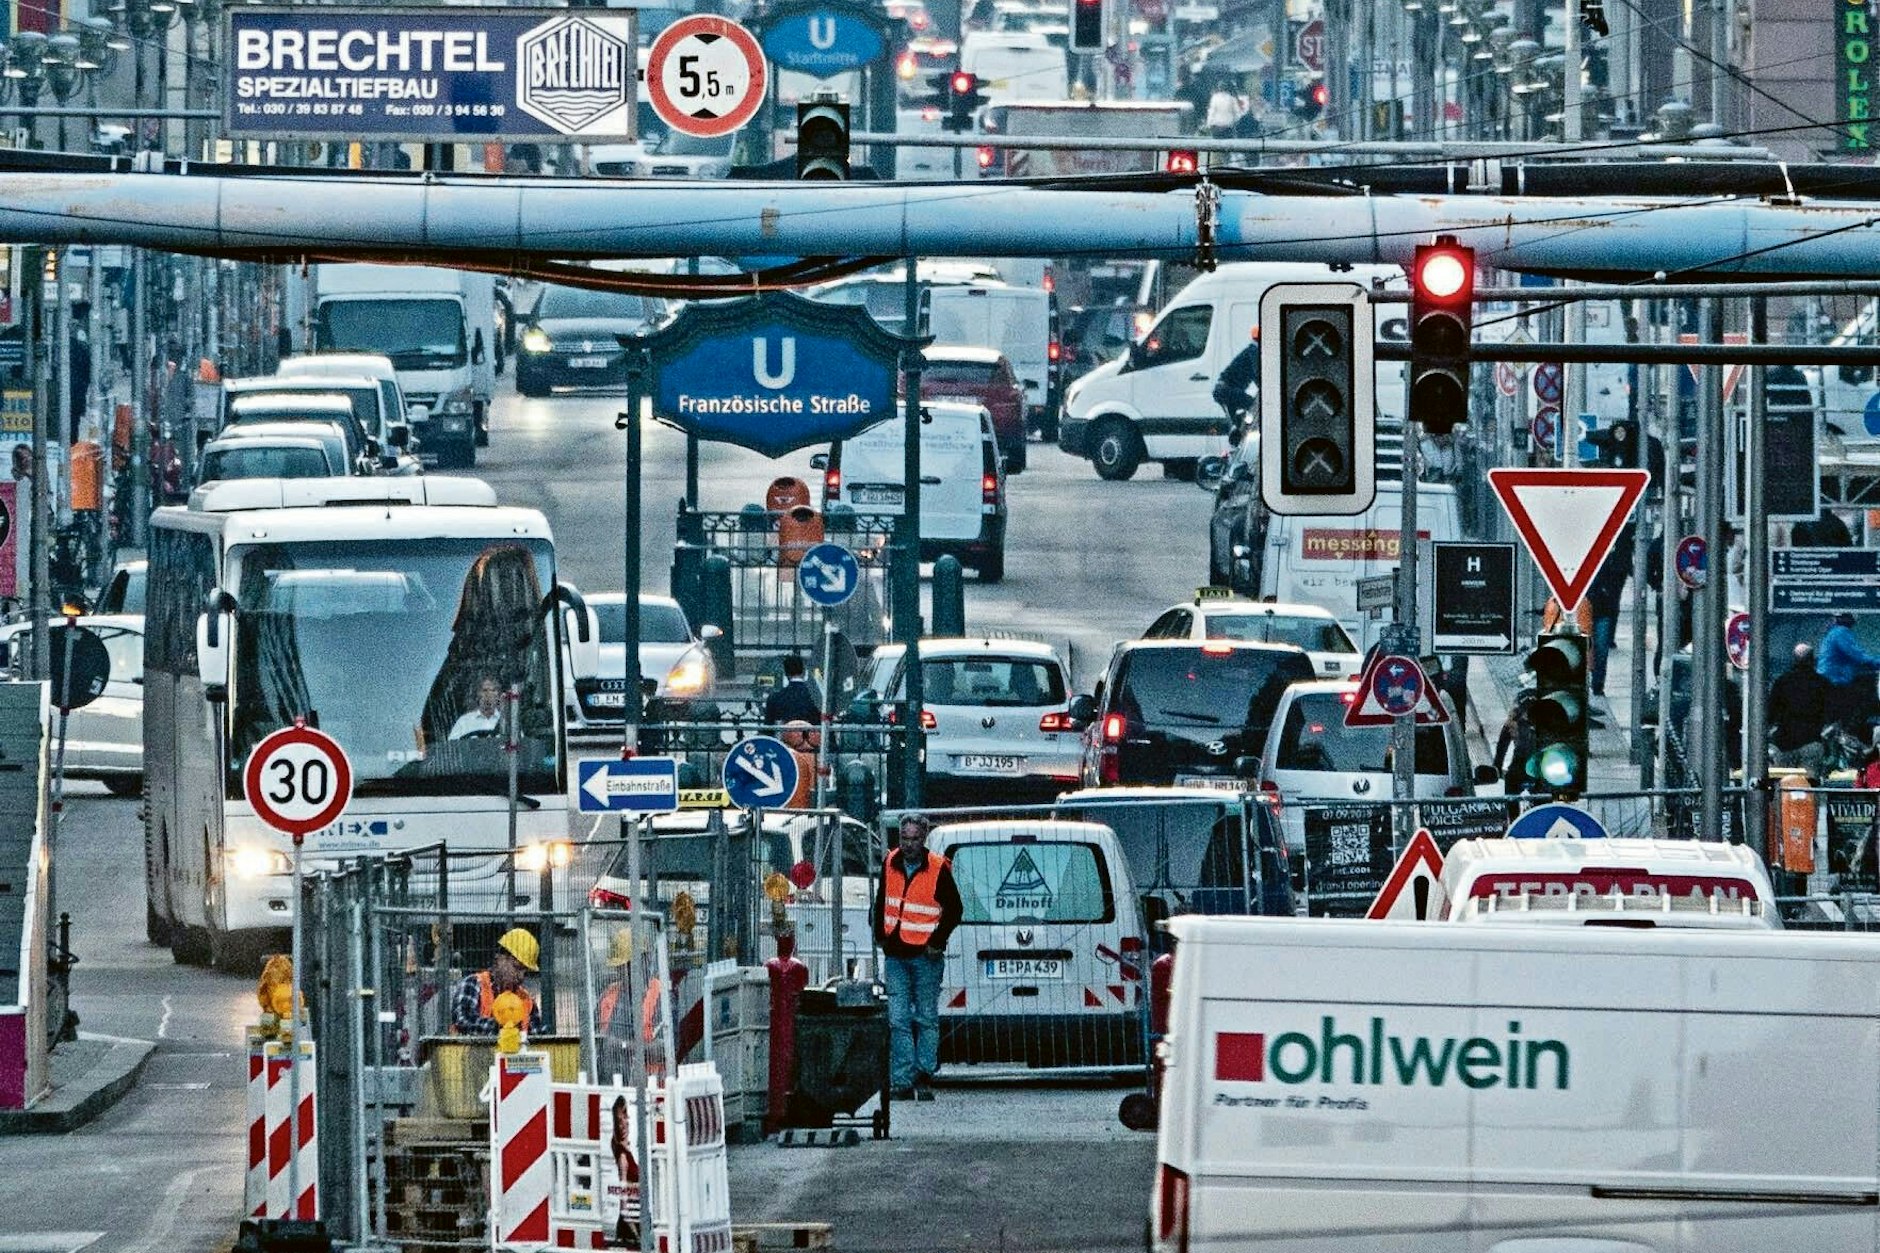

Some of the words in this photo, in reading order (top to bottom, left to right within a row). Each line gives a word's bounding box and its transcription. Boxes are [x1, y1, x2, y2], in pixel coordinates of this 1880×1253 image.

[809, 17, 836, 50] U
[237, 29, 505, 72] BRECHTEL
[532, 22, 621, 89] BRECHTEL
[1302, 36, 1325, 58] ST
[679, 55, 721, 100] 5,5
[725, 84, 735, 97] m
[237, 77, 438, 99] SPEZIALTIEFBAU
[238, 104, 262, 115] Tel.:
[263, 104, 286, 115] 030
[385, 104, 410, 116] Fax:
[412, 105, 435, 116] 030
[444, 105, 453, 116] 3
[455, 105, 471, 116] 94
[753, 337, 796, 390] U
[678, 394, 803, 414] Französische
[810, 394, 871, 414] Straße
[1307, 538, 1401, 556] messeng
[1467, 556, 1481, 573] H
[964, 757, 972, 768] B
[269, 758, 328, 805] 30
[606, 780, 671, 792] Einbahnstraße
[1423, 815, 1465, 827] VOICES
[1483, 825, 1504, 833] TOUR
[995, 896, 1053, 910] Dalhoff
[999, 961, 1007, 974] B
[1034, 961, 1058, 975] 439
[1268, 1015, 1569, 1090] ohlwein
[1214, 1093, 1281, 1108] Partner
[1285, 1094, 1310, 1109] für
[1315, 1095, 1370, 1111] Profis
